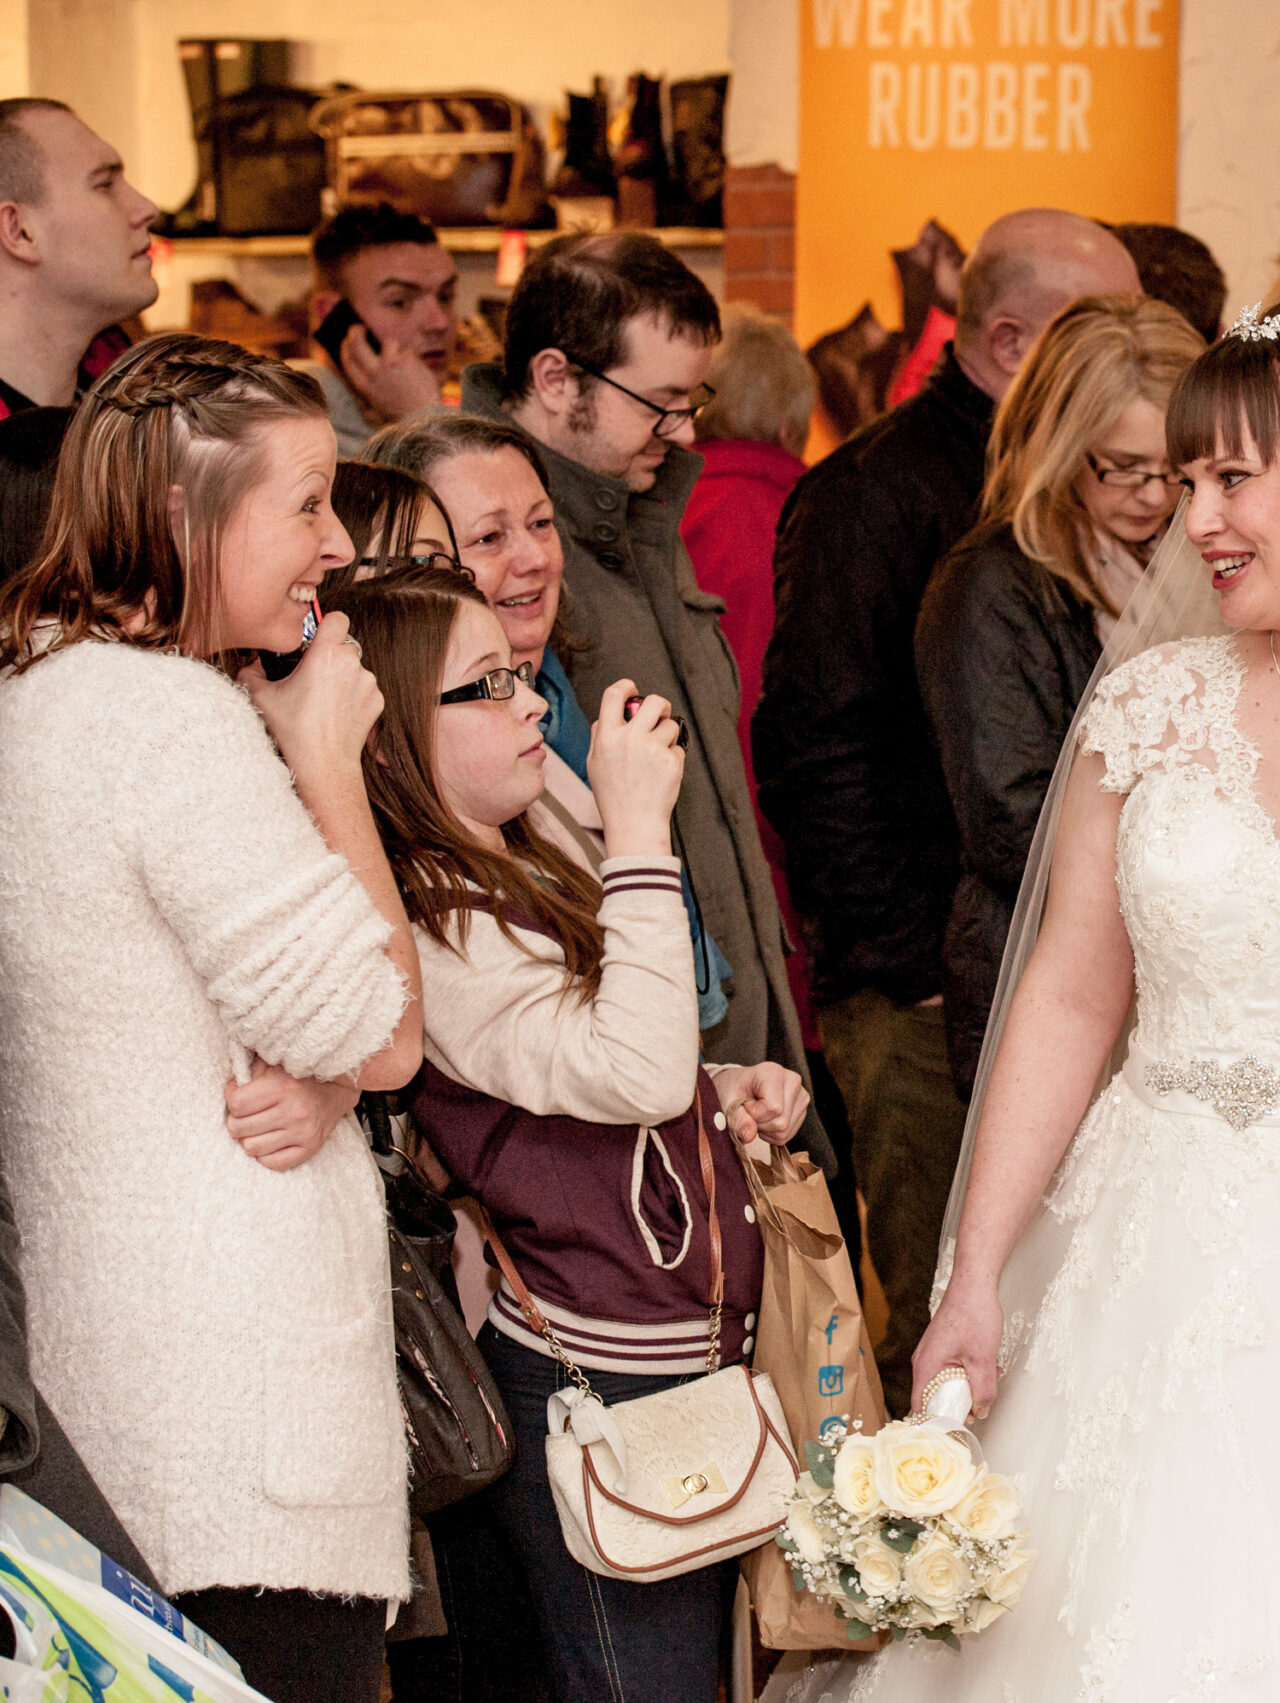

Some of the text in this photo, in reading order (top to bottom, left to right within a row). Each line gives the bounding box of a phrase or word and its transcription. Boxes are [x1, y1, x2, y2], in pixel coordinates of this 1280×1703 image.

[812, 0, 1163, 49] WEAR MORE
[867, 60, 1094, 151] RUBBER
